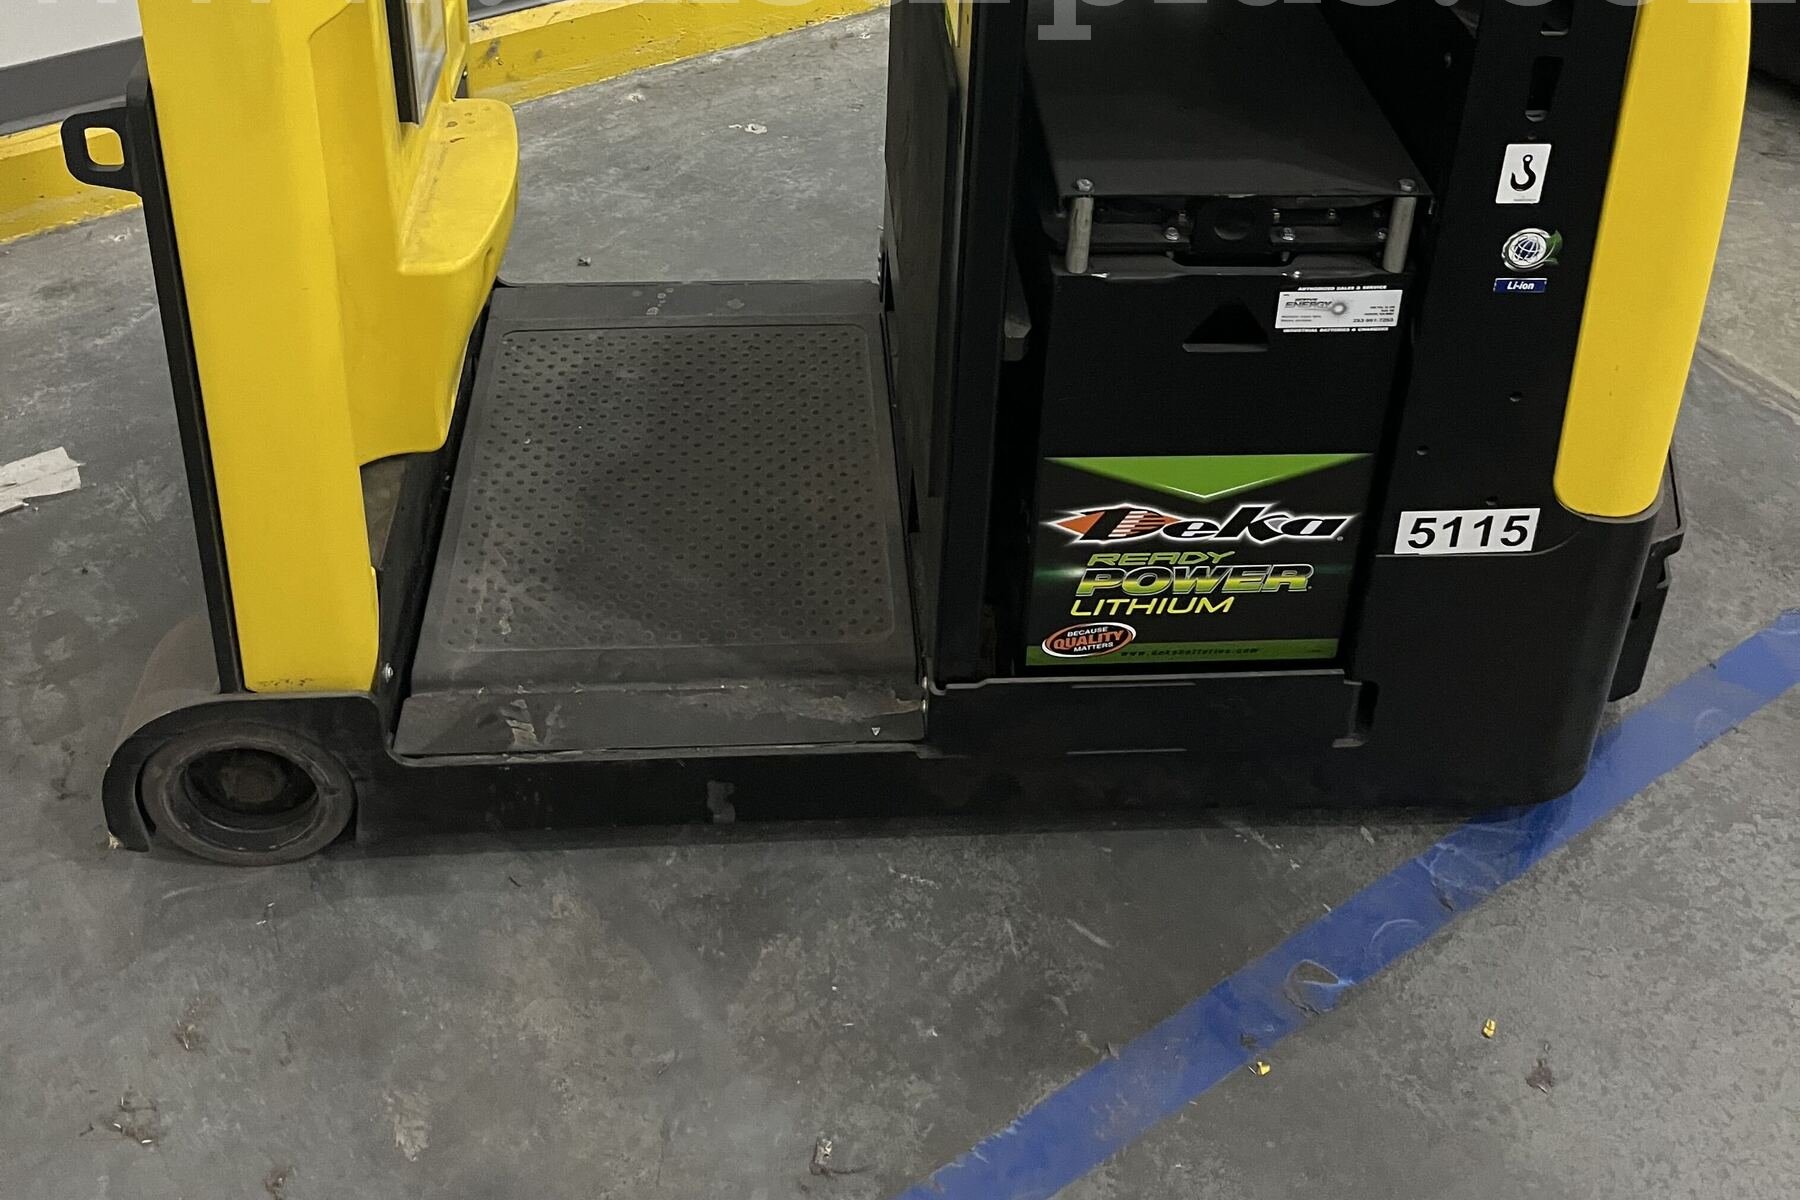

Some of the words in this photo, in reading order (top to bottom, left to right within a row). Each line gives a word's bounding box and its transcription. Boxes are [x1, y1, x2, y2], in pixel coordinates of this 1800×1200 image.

[1506, 281, 1535, 290] Li-ion
[1043, 502, 1355, 544] Deka
[1407, 515, 1530, 548] 5115
[1087, 551, 1235, 567] READY
[1075, 563, 1314, 597] POWER
[1070, 597, 1235, 617] LITHIUM
[1053, 629, 1124, 650] QUALITY
[1067, 626, 1109, 637] BECAUSE
[1073, 641, 1114, 652] MATTERS
